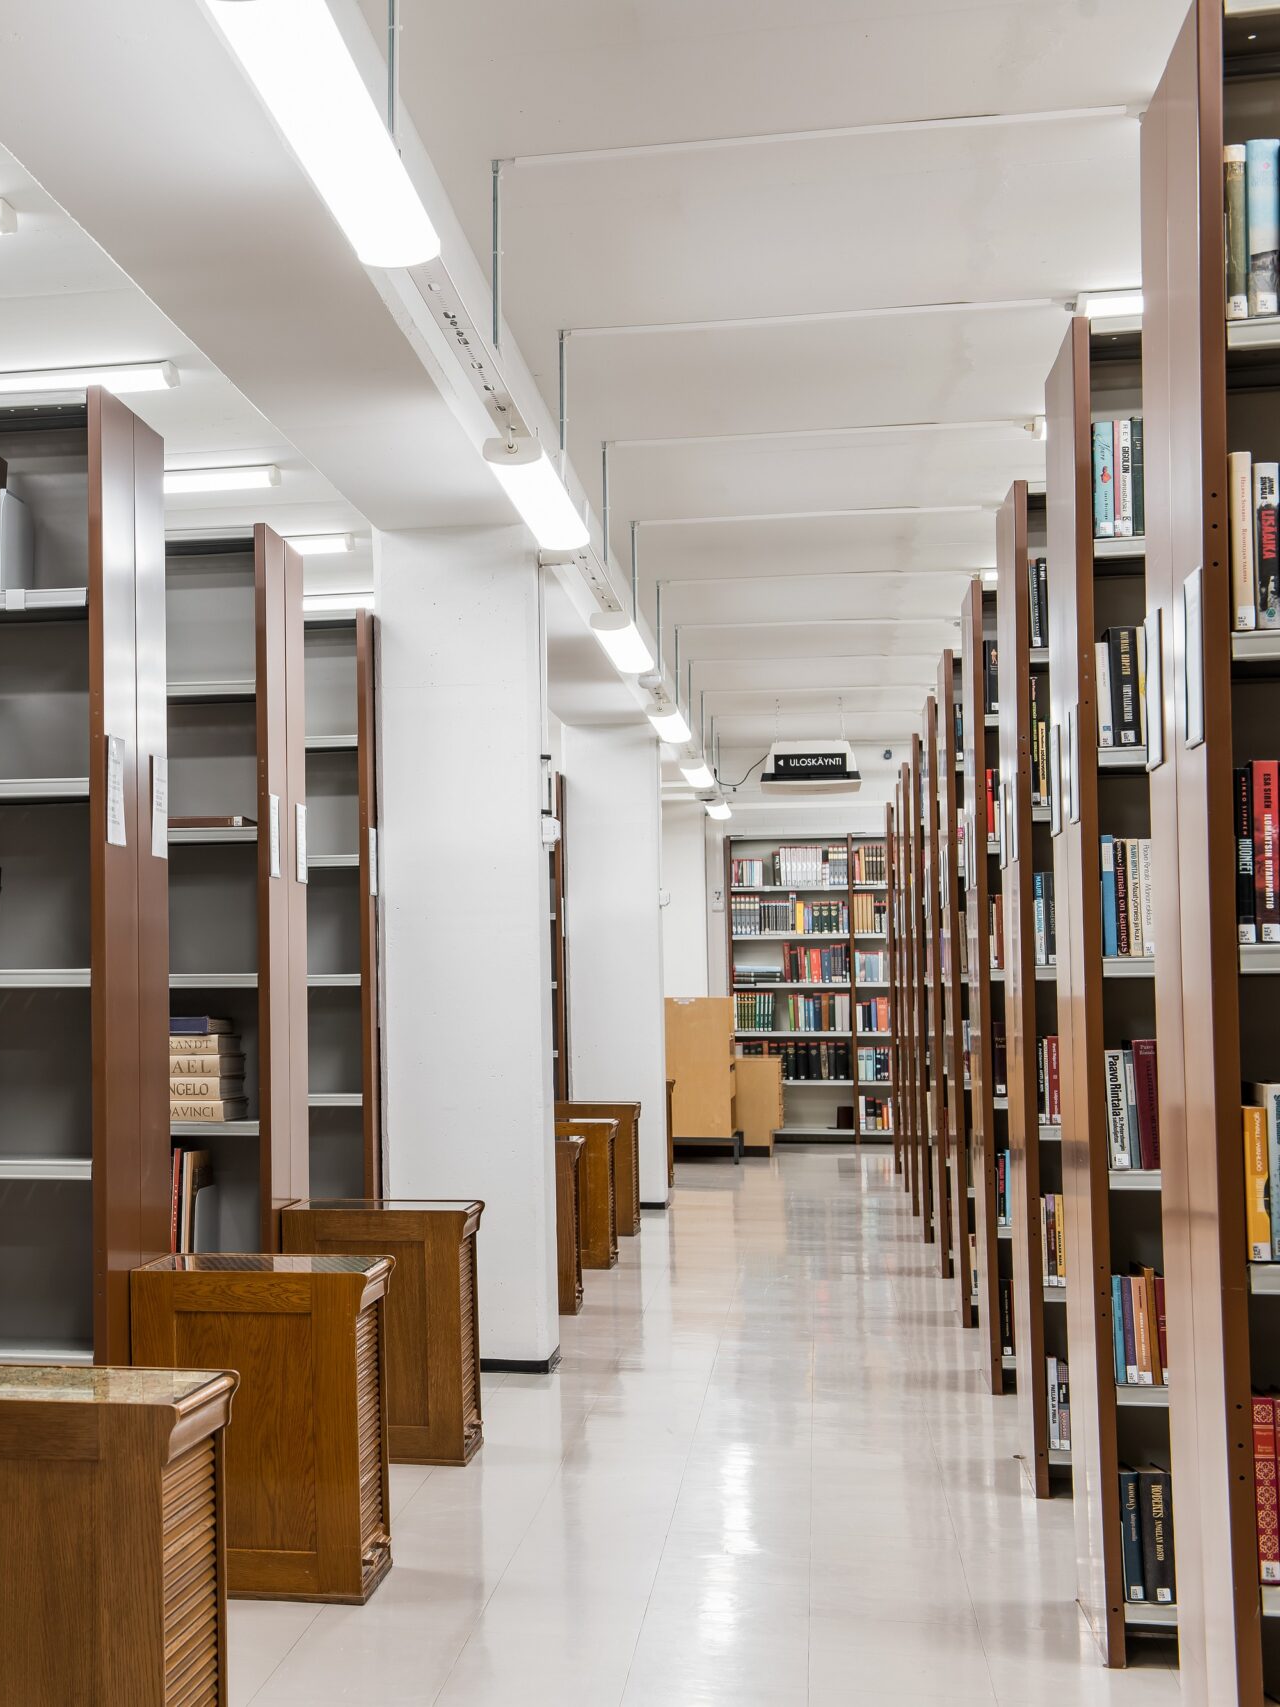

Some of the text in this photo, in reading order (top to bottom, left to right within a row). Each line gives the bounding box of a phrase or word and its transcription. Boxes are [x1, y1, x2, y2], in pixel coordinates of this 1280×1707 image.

[1122, 446, 1130, 474] GIGOLON
[1261, 510, 1277, 559] LISÄAIKA
[1121, 654, 1131, 675] RIDPATH
[790, 757, 842, 767] ULOSKÄYNTI
[1264, 814, 1274, 857] ILOMANTSIN
[1238, 838, 1253, 875] HUONEET
[1116, 867, 1126, 897] Jumala
[1265, 860, 1275, 909] RITARIPARTIO
[1119, 899, 1126, 911] on
[1120, 913, 1129, 952] kauneus
[1108, 1055, 1120, 1082] Paavo
[170, 1107, 214, 1117] AVINCI
[1109, 1084, 1123, 1116] Rintala
[1151, 1485, 1164, 1561] ROBERTS ANGELAN KOSTO
